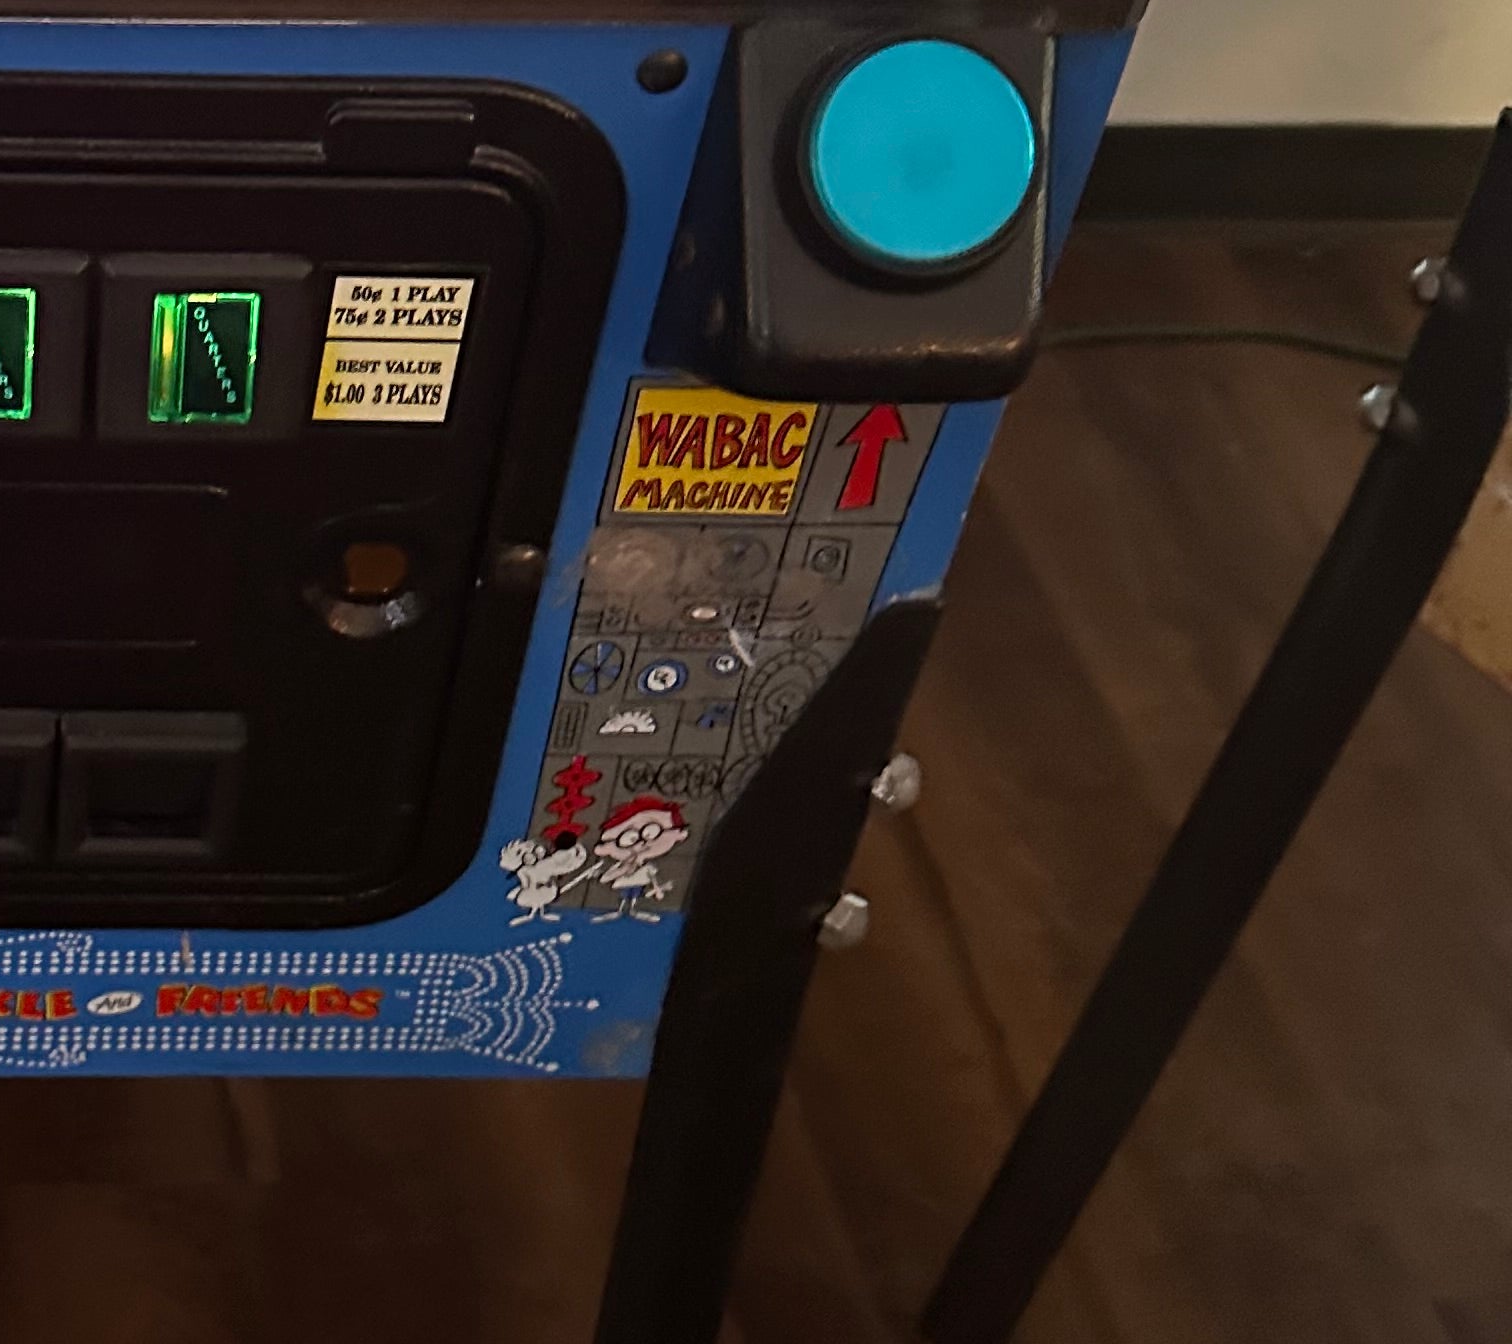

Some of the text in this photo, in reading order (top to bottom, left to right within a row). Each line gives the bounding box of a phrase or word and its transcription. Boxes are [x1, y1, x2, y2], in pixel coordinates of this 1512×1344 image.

[351, 285, 461, 304] 50¢ 1 PLAY
[334, 307, 463, 327] 75¢ 2 PLAYS
[194, 305, 237, 404] QUARTERS
[335, 359, 442, 375] BEST VALUE
[323, 380, 443, 406] $1.00 3 PLAYS
[636, 411, 808, 471] WABAC
[620, 478, 795, 511] MACHINE
[156, 983, 385, 1020] FRIENDS
